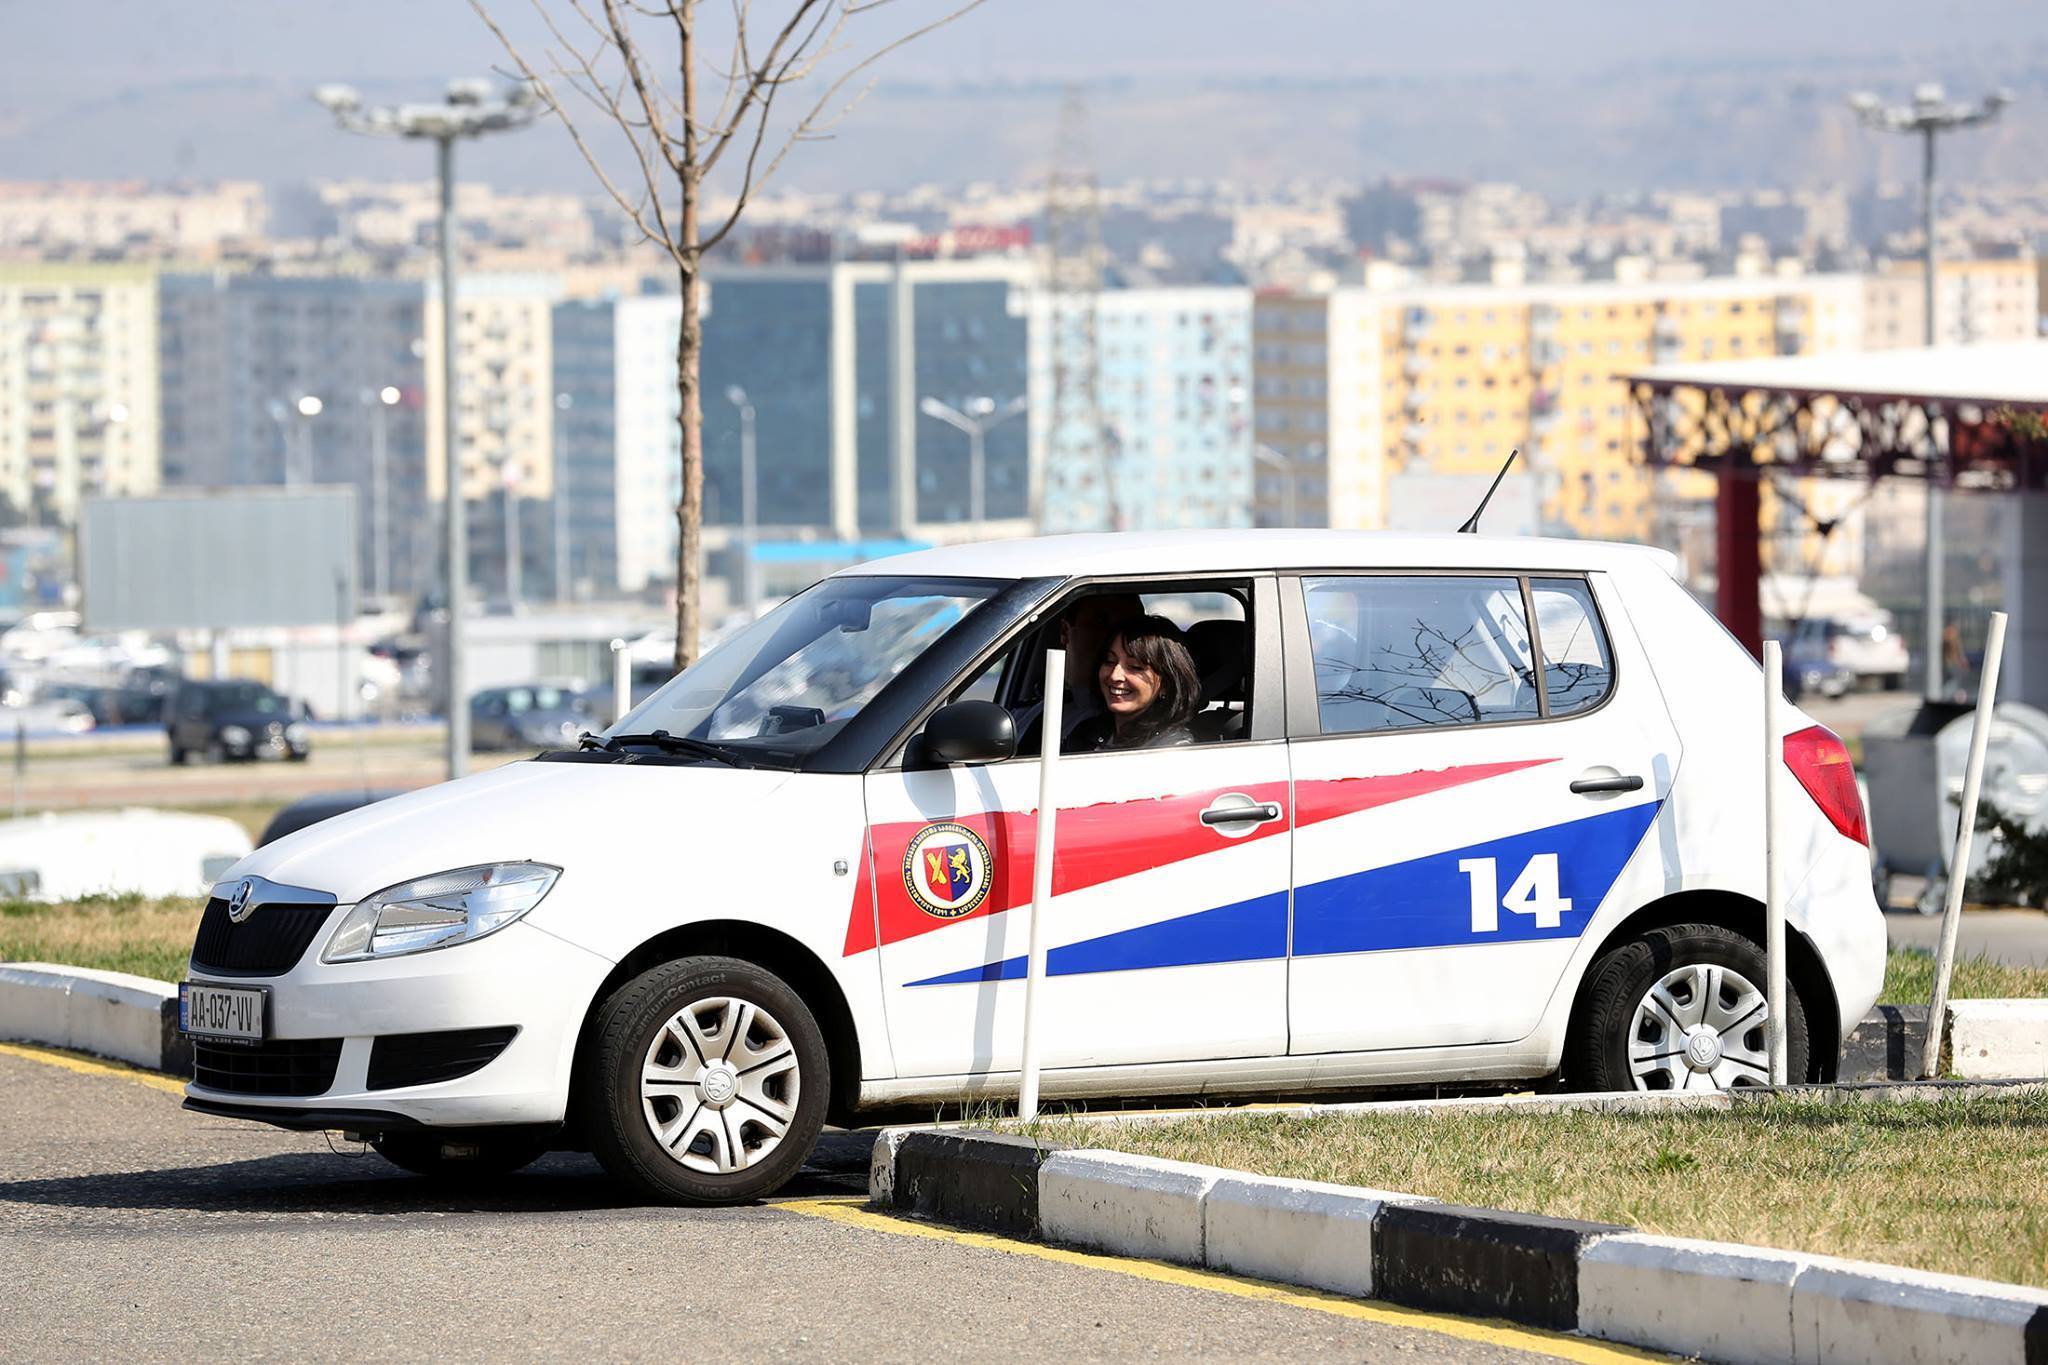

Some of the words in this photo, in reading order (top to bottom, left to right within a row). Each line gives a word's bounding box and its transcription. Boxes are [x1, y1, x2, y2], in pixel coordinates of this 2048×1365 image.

[1458, 853, 1572, 933] 14
[191, 991, 253, 1032] AA-037-VV
[625, 972, 727, 1053] PremiumContact
